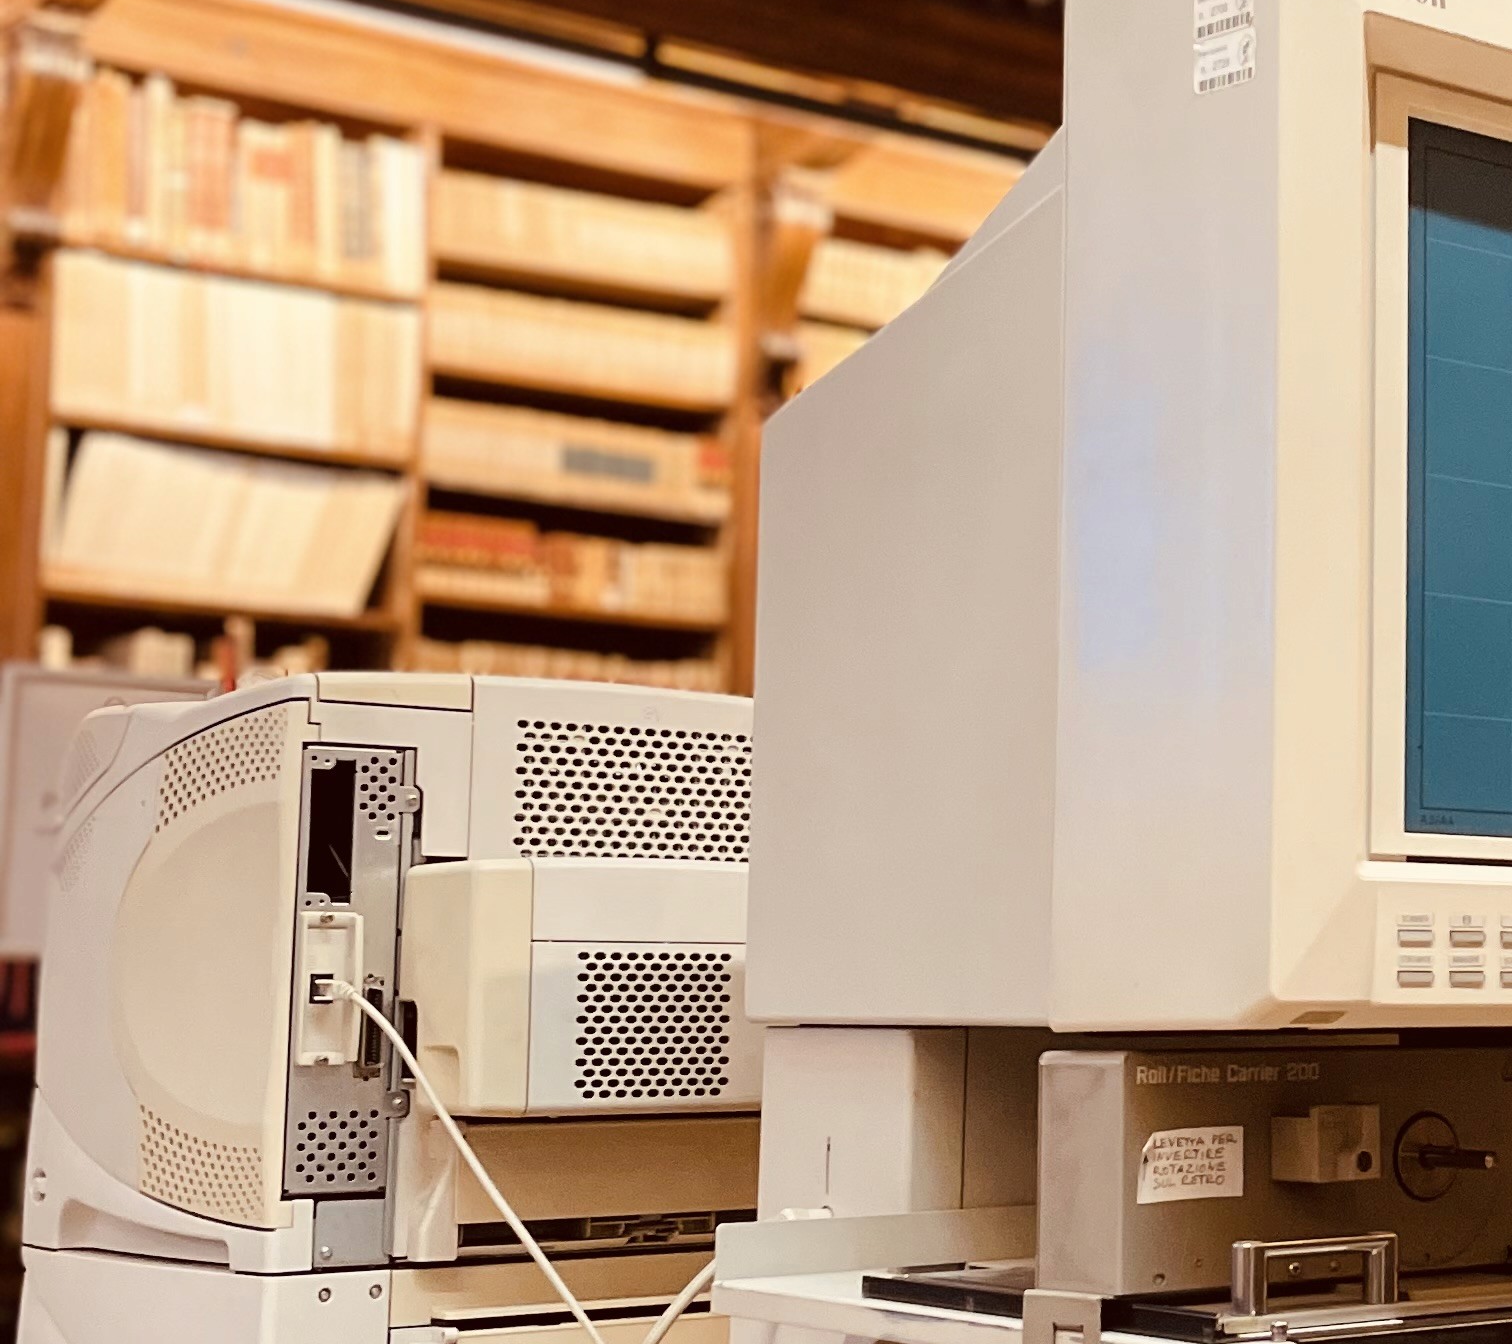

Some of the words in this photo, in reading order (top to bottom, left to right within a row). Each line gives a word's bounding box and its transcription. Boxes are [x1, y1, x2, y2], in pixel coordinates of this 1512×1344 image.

[1136, 1065, 1220, 1084] Roll/Fiche
[1227, 1064, 1280, 1082] Carrier
[1286, 1062, 1320, 1080] 200
[1153, 1136, 1205, 1150] LEVETTA
[1211, 1133, 1238, 1145] PER
[1152, 1177, 1177, 1190] SUL
